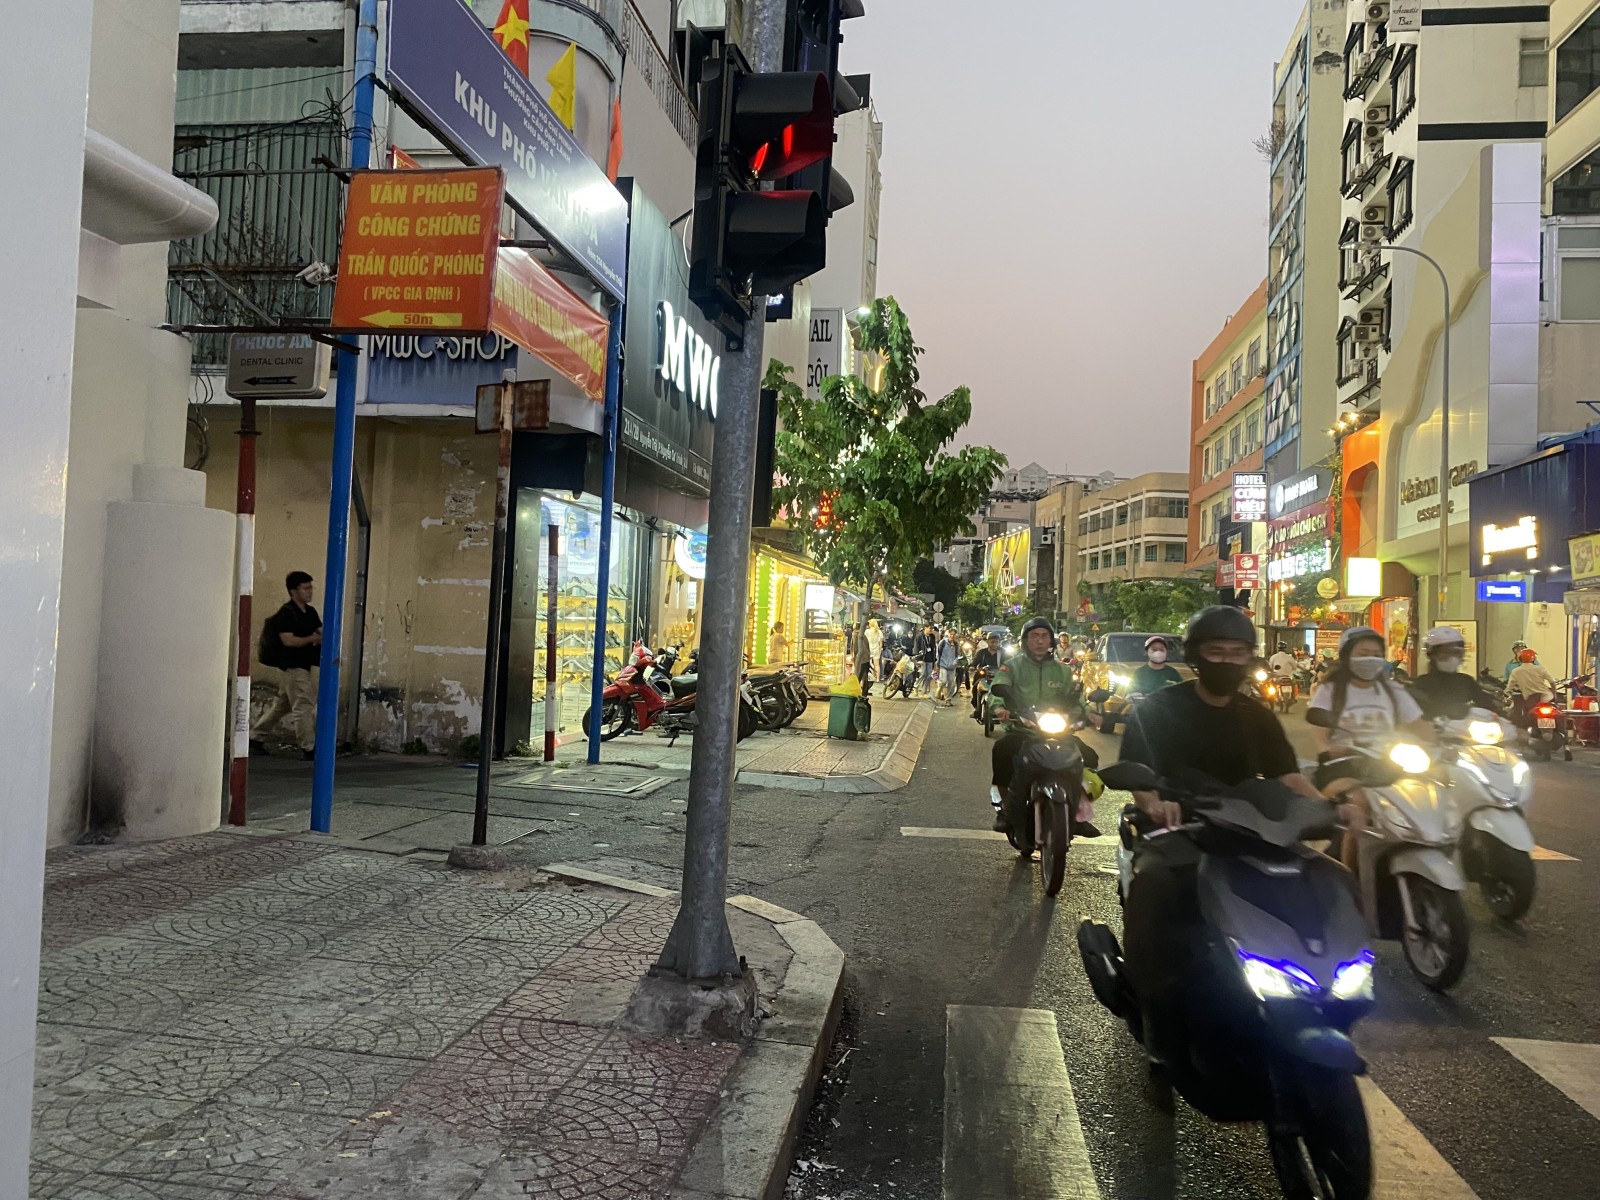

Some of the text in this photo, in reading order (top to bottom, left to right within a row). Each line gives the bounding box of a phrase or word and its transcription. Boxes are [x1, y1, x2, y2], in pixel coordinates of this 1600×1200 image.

[455, 70, 497, 138] KHU
[501, 121, 537, 180] PHỐ
[370, 179, 478, 204] VĂN PHÒNG
[358, 211, 481, 237] CÔNG CHỨNG
[348, 248, 485, 277] TRẦN QUỐC PHÒNG
[404, 286, 422, 300] GIA
[403, 314, 433, 325] 50m
[809, 319, 832, 342] AIL
[240, 357, 304, 366] DENTAL CLINIC
[1235, 475, 1266, 485] HOTEL
[1401, 476, 1438, 505] Maison
[1239, 513, 1262, 521] 283
